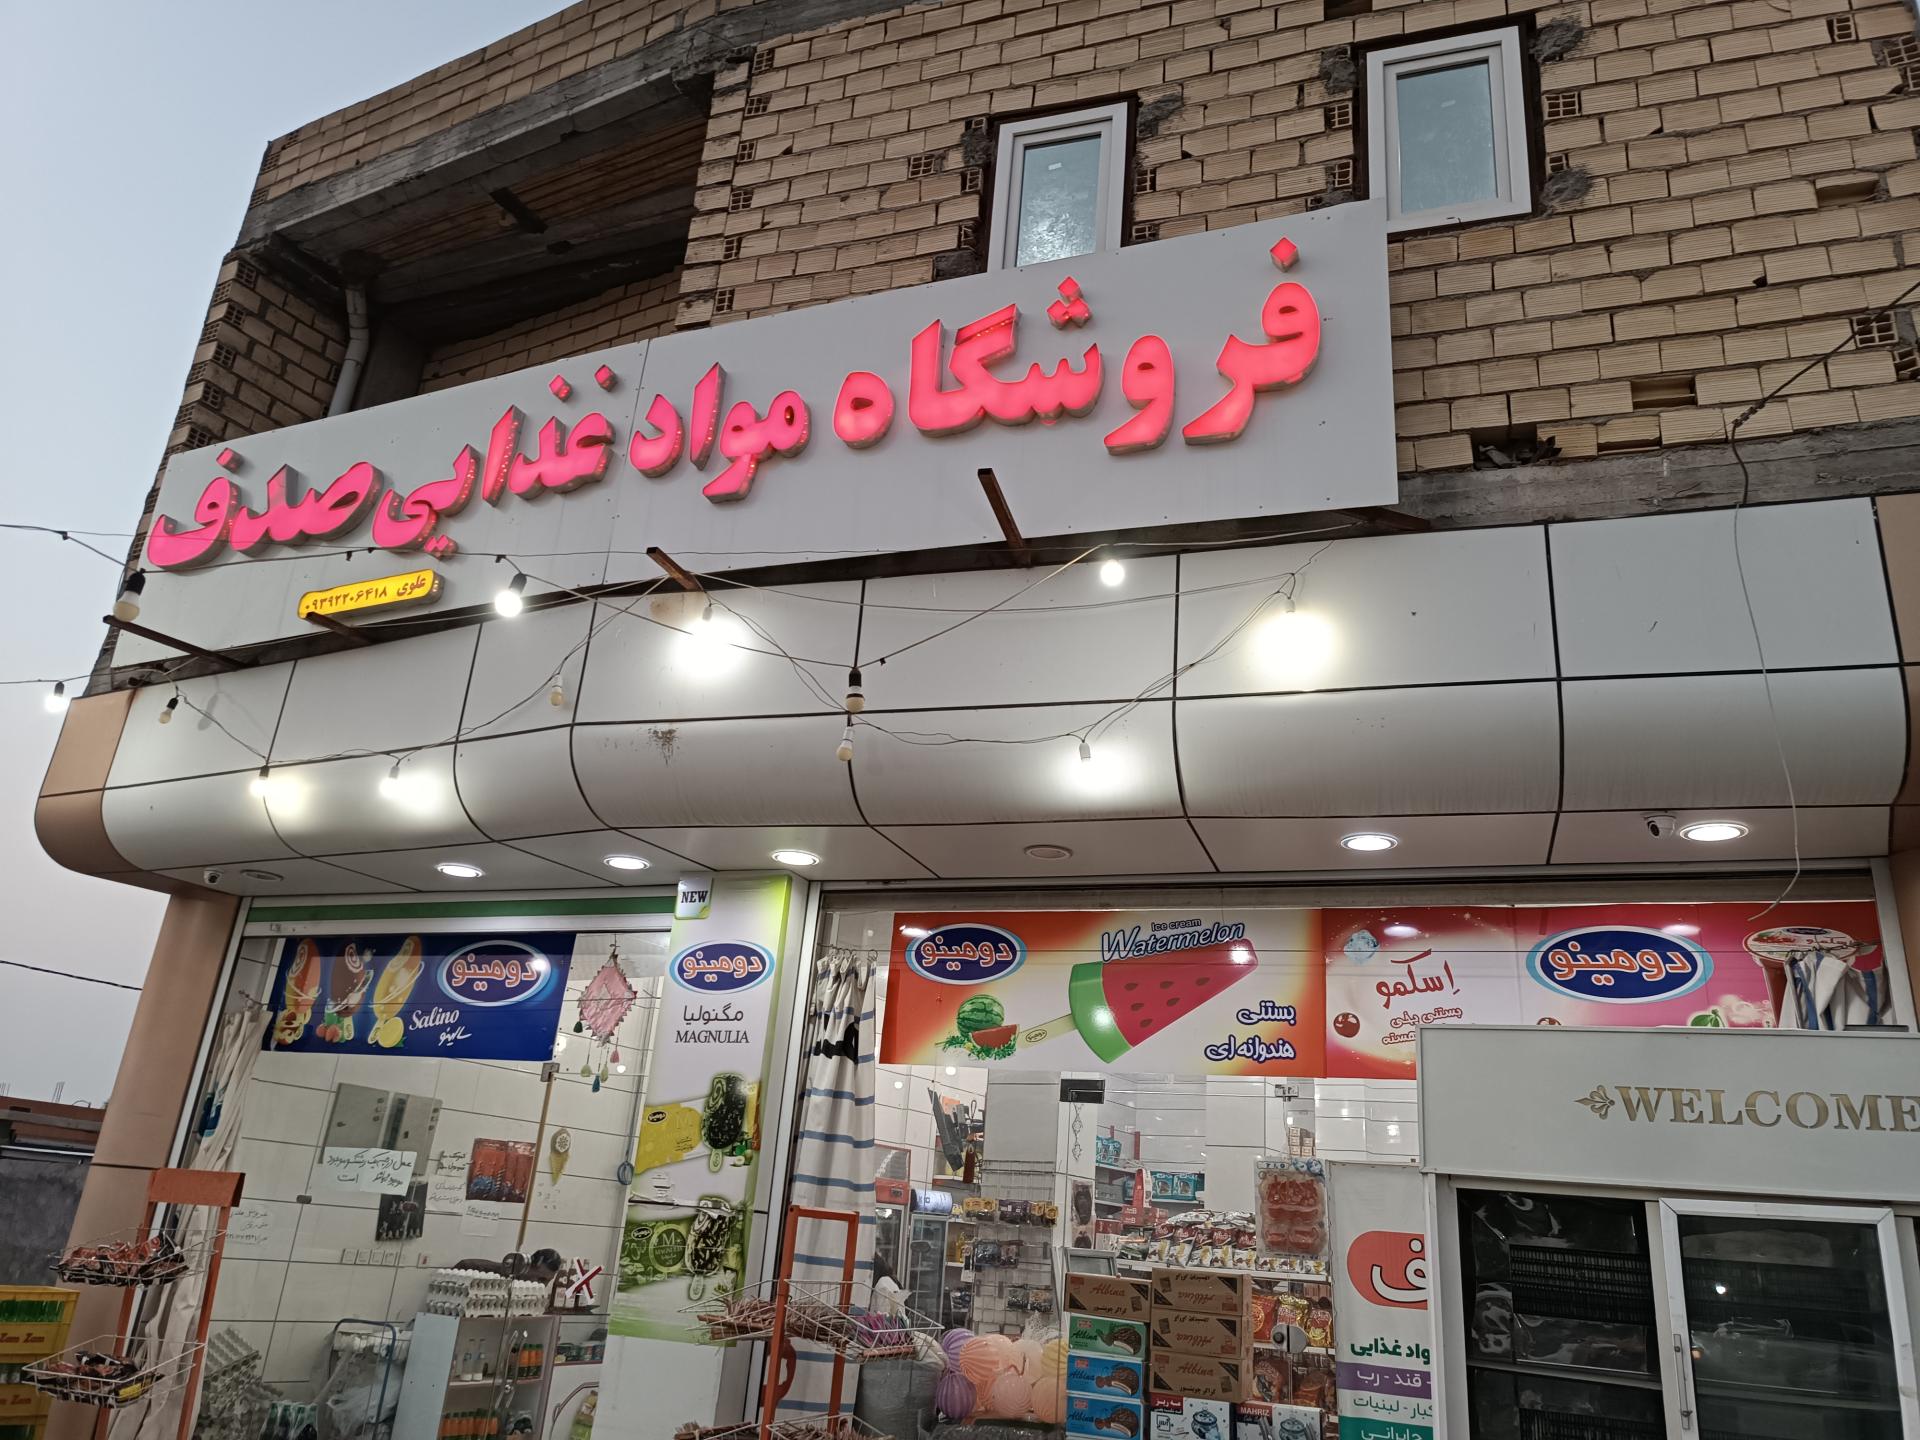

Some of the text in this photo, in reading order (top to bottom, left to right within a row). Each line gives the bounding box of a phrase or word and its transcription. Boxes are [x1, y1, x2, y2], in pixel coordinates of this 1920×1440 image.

[146, 237, 1321, 571] فروشگاه مواد غذایی صدف
[396, 575, 427, 598] علوی
[681, 890, 709, 904] NEW
[1151, 918, 1201, 932] Ice cream
[1102, 921, 1246, 962] Watermelon
[920, 936, 1014, 971] دومینو
[451, 953, 538, 992] دومینو
[683, 951, 763, 983] دومینو
[1547, 940, 1692, 987] دومینو
[408, 1005, 460, 1031] Salino
[683, 1003, 744, 1025] مگنولیا
[1237, 1000, 1296, 1026] بستنی
[1421, 1007, 1463, 1024] بستنی
[675, 1030, 749, 1044] MAGNULIA
[1614, 1085, 1920, 1132] WELCOME
[1089, 1282, 1126, 1297] Albina
[1071, 1329, 1098, 1341] Albina
[1351, 1337, 1431, 1365] واد غذایی
[1069, 1369, 1096, 1382] Albina
[1176, 1361, 1215, 1377] Albina
[1357, 1369, 1380, 1387] رب
[1394, 1371, 1422, 1388] قند
[1240, 1407, 1270, 1417] MAHRIZ
[1354, 1395, 1399, 1414] لبنیات
[1068, 1411, 1095, 1423] Albina
